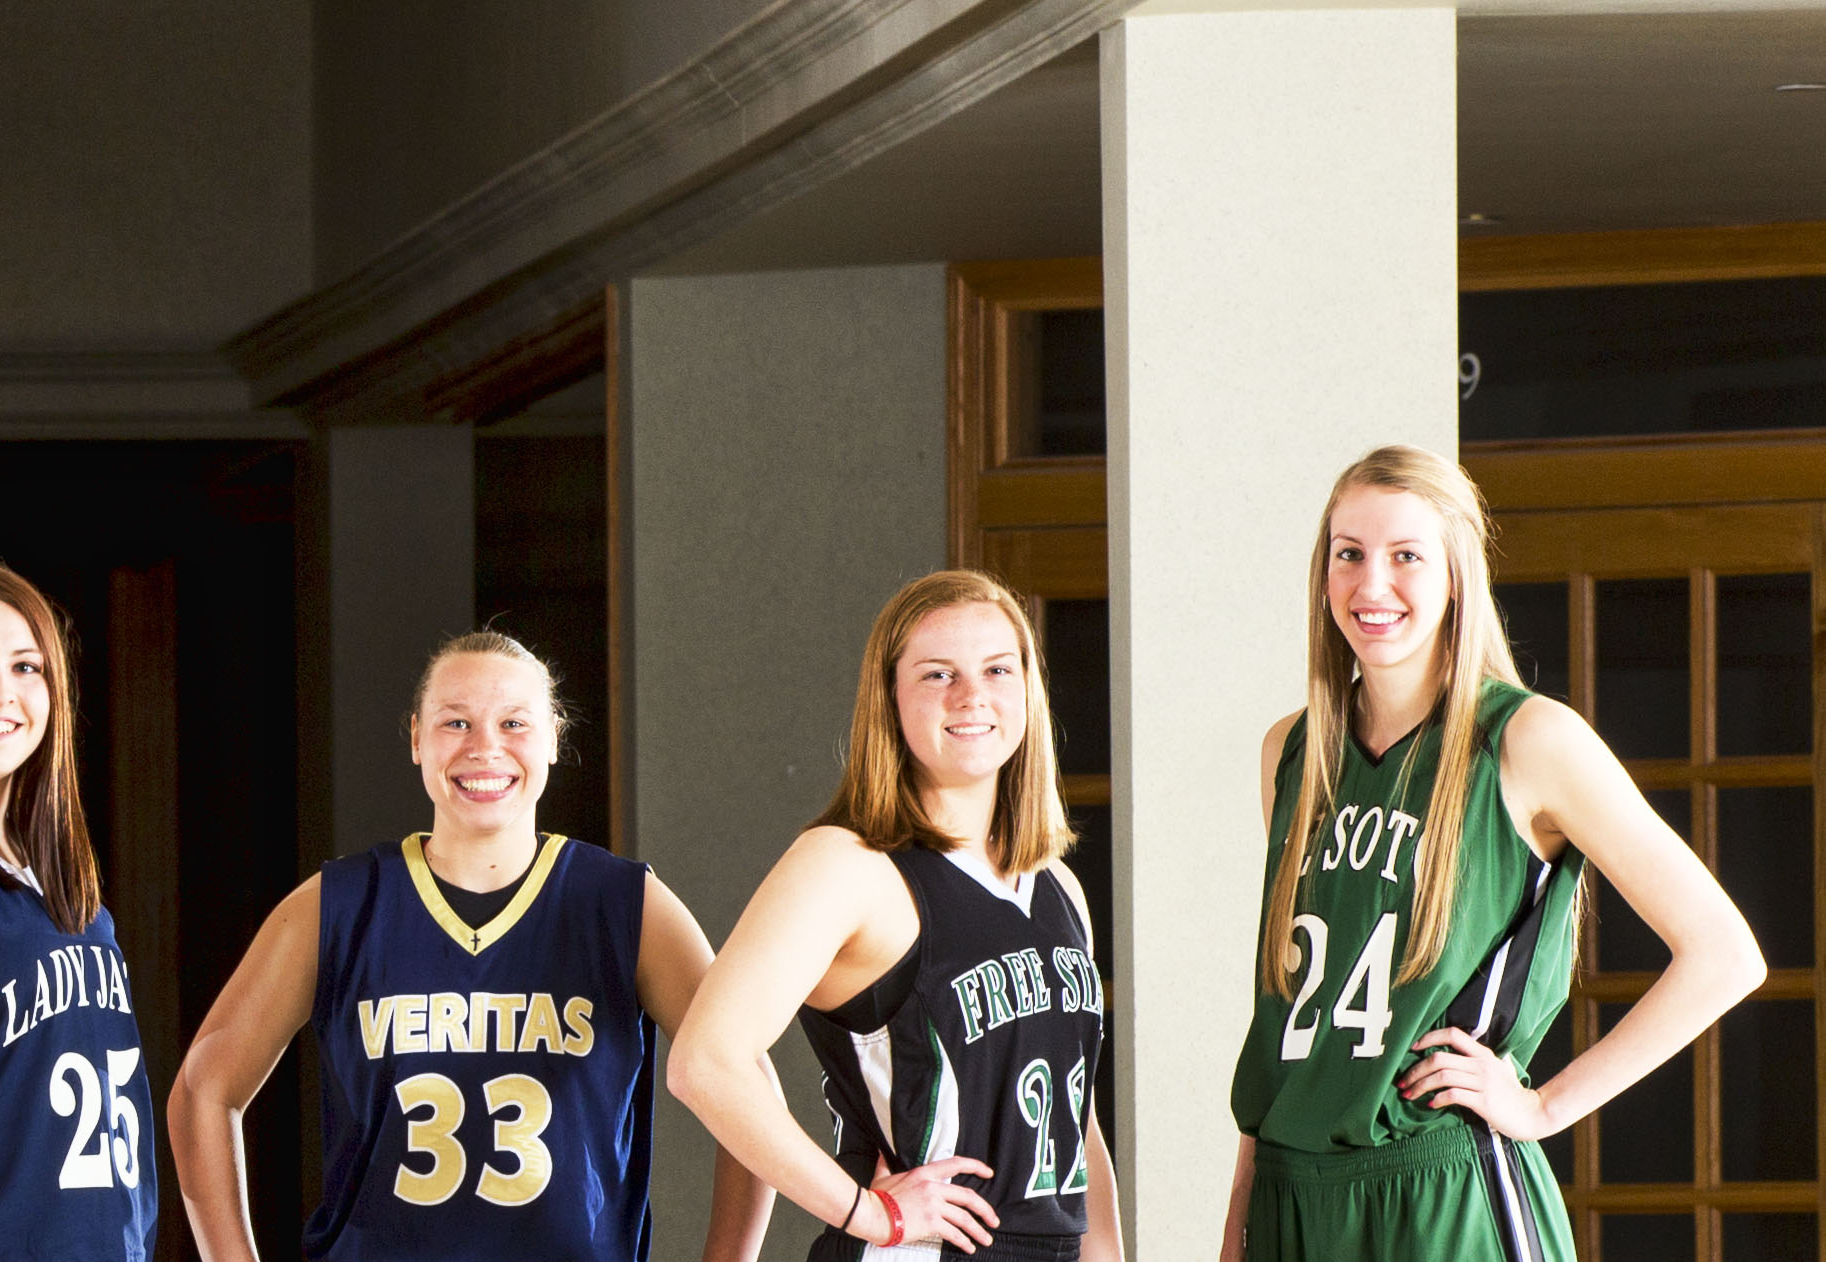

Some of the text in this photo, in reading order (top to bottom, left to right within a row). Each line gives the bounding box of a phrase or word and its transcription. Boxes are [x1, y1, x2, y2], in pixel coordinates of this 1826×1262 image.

[1458, 352, 1482, 400] 9
[1, 945, 132, 1047] LADY JA
[357, 992, 595, 1060] VERITAS
[951, 948, 1051, 1045] FREE
[1280, 912, 1398, 1063] 24
[49, 1047, 141, 1190] 25
[393, 1073, 553, 1206] 33
